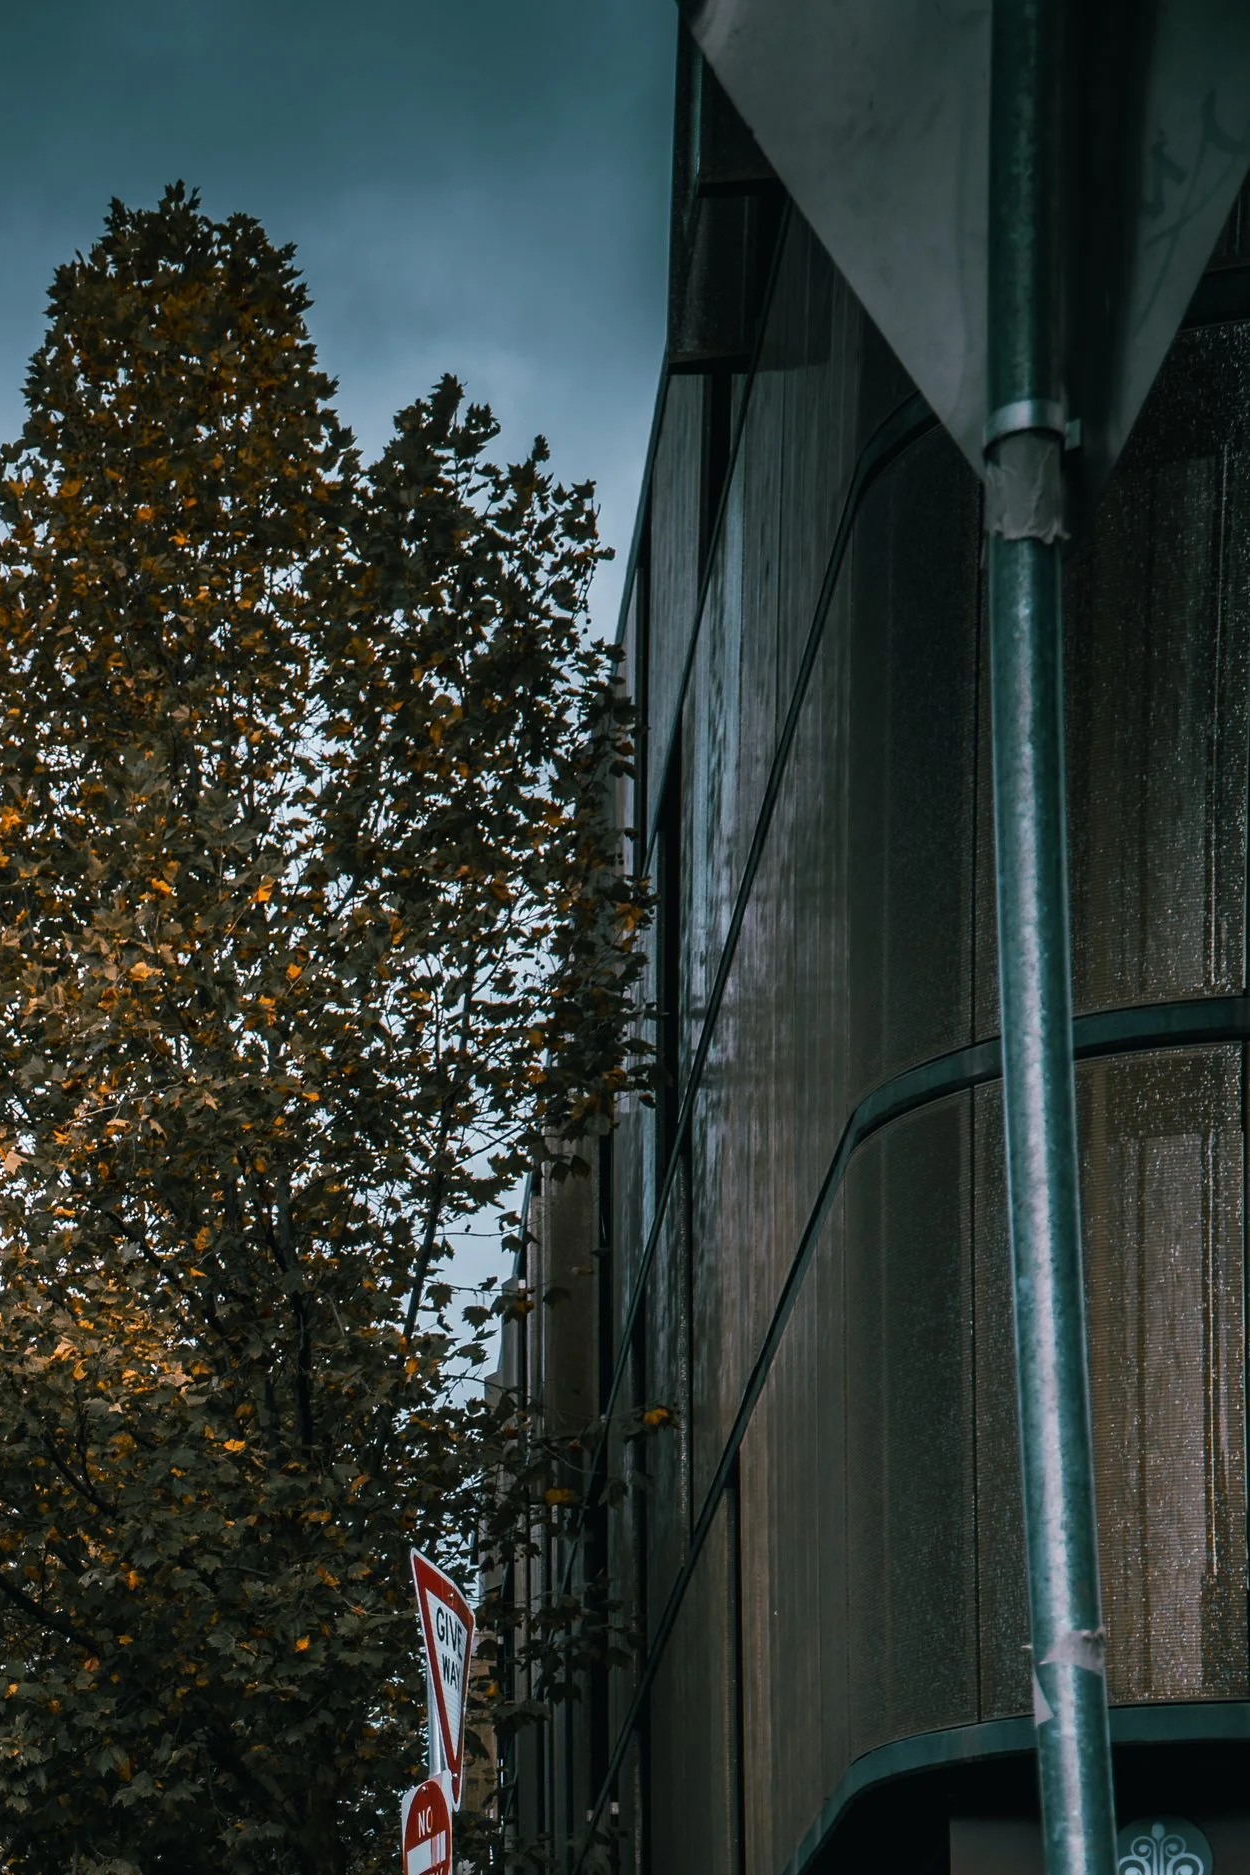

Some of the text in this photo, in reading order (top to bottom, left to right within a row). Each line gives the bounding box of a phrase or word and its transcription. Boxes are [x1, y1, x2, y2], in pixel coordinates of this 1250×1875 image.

[436, 1606, 463, 1662] GIVE
[442, 1653, 461, 1693] WAY
[418, 1806, 434, 1839] NO
